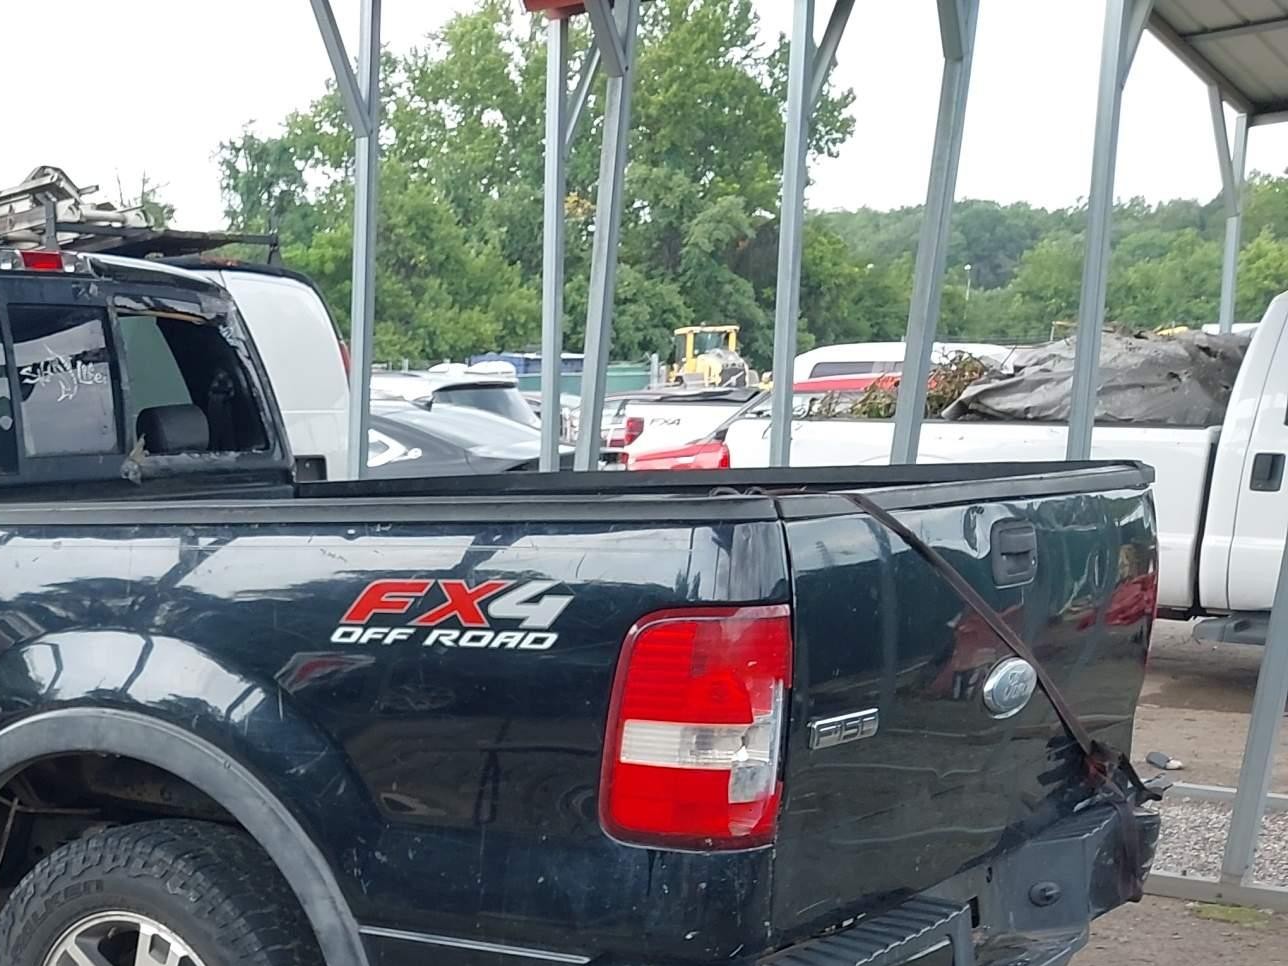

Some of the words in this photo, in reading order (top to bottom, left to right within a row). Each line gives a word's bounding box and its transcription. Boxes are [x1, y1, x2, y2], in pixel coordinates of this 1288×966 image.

[340, 579, 576, 630] FX4
[330, 627, 416, 646] OFF
[422, 628, 559, 650] ROAD
